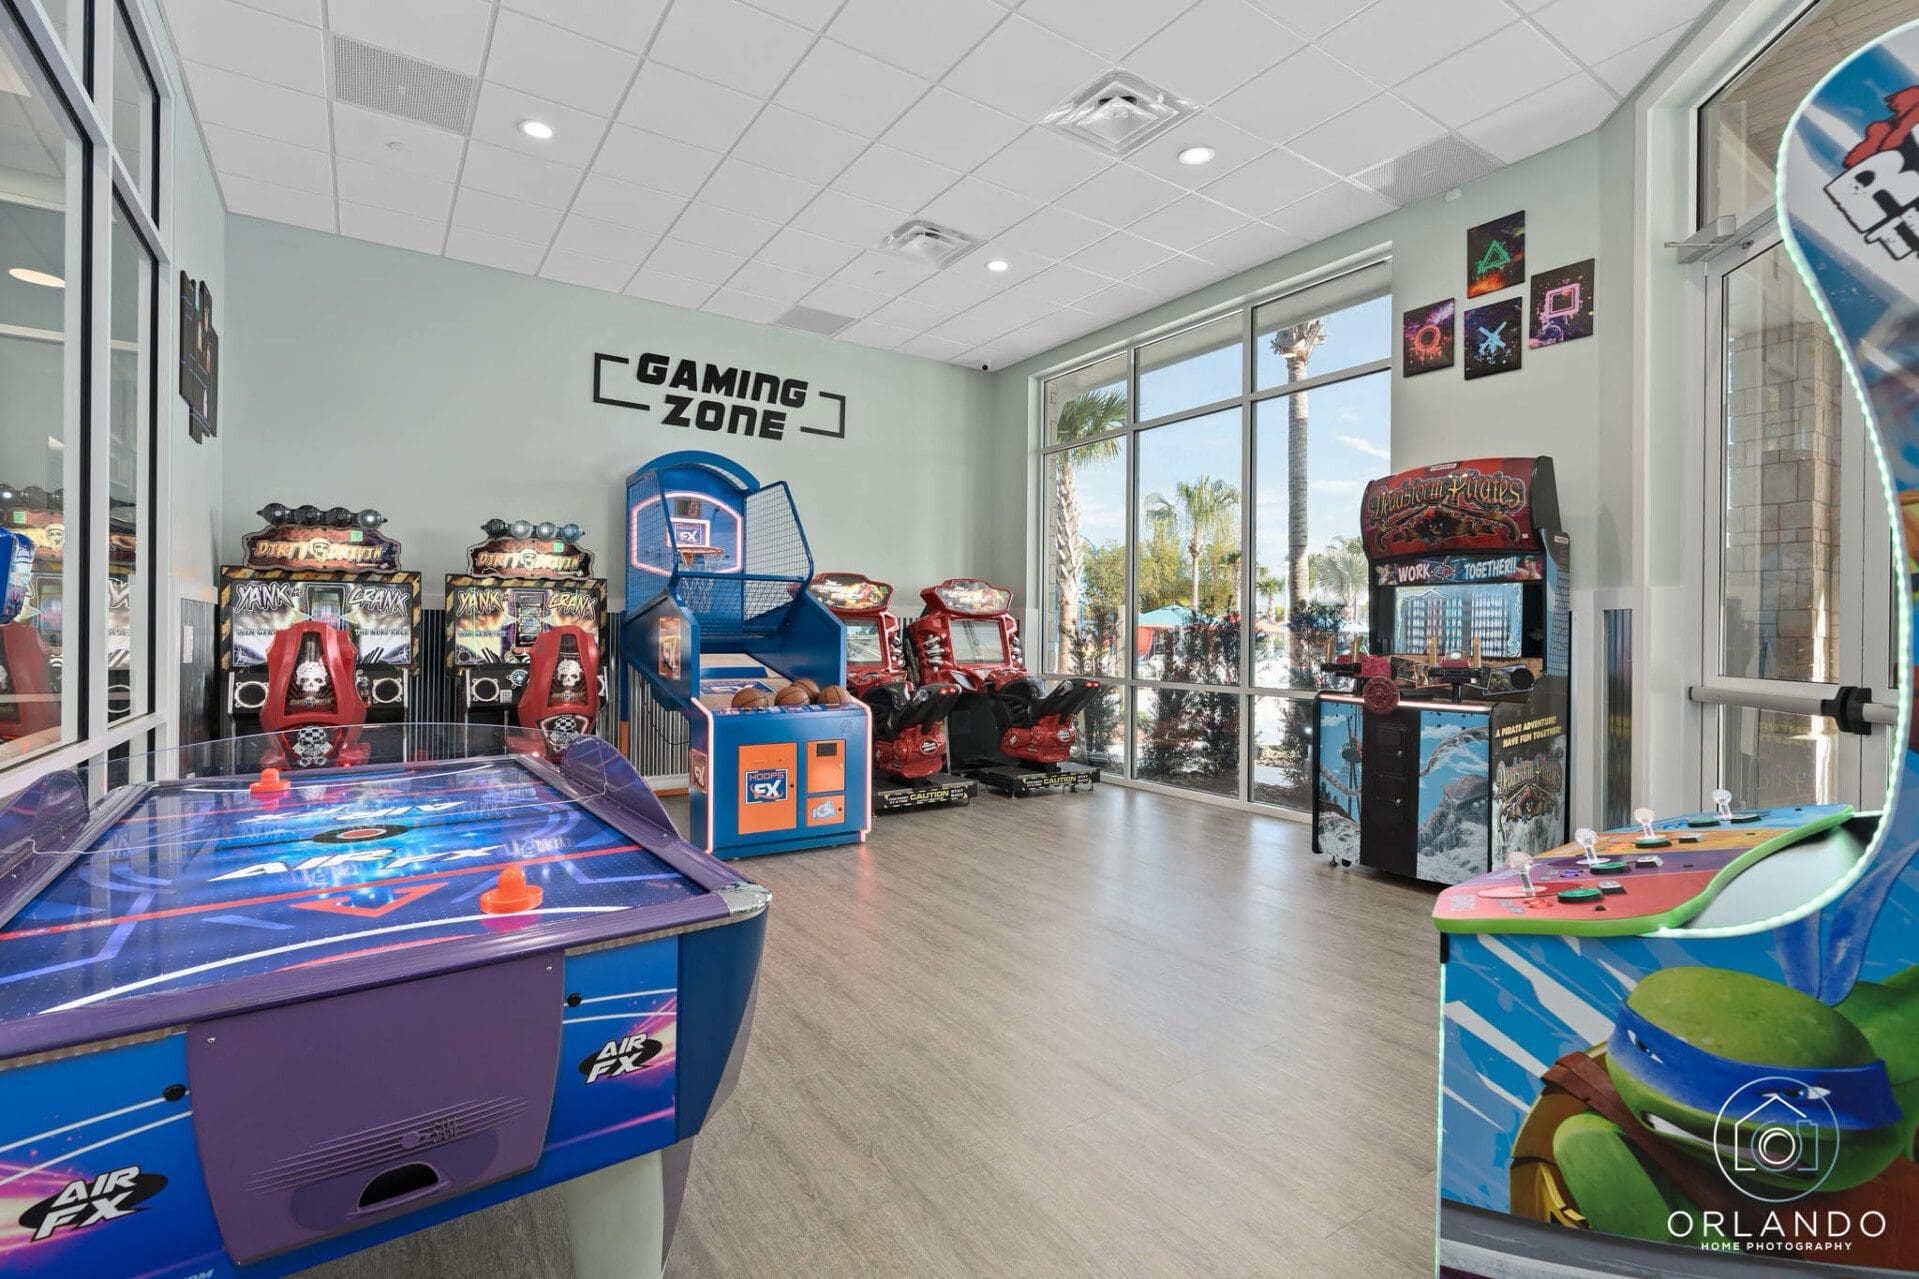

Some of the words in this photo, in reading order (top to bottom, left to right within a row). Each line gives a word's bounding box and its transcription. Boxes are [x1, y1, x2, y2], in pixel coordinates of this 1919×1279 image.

[636, 352, 809, 409] GAMING
[661, 394, 788, 441] ZONE
[1398, 564, 1431, 582] WORK
[1464, 556, 1517, 580] TOGETHER!!
[235, 582, 294, 614] YANK
[346, 584, 409, 619] CRANK
[456, 588, 504, 618] YANK
[546, 590, 598, 622] CRANK
[1495, 729, 1501, 738] A
[748, 771, 785, 781] HOOPS
[754, 779, 781, 798] FX
[1043, 775, 1077, 785] CAUTION
[909, 789, 949, 801] CAUTION
[206, 847, 397, 882] AIR
[596, 1031, 648, 1061] AIR
[585, 1050, 645, 1084] FX
[49, 1165, 142, 1209] AIR
[30, 1190, 143, 1242] FX
